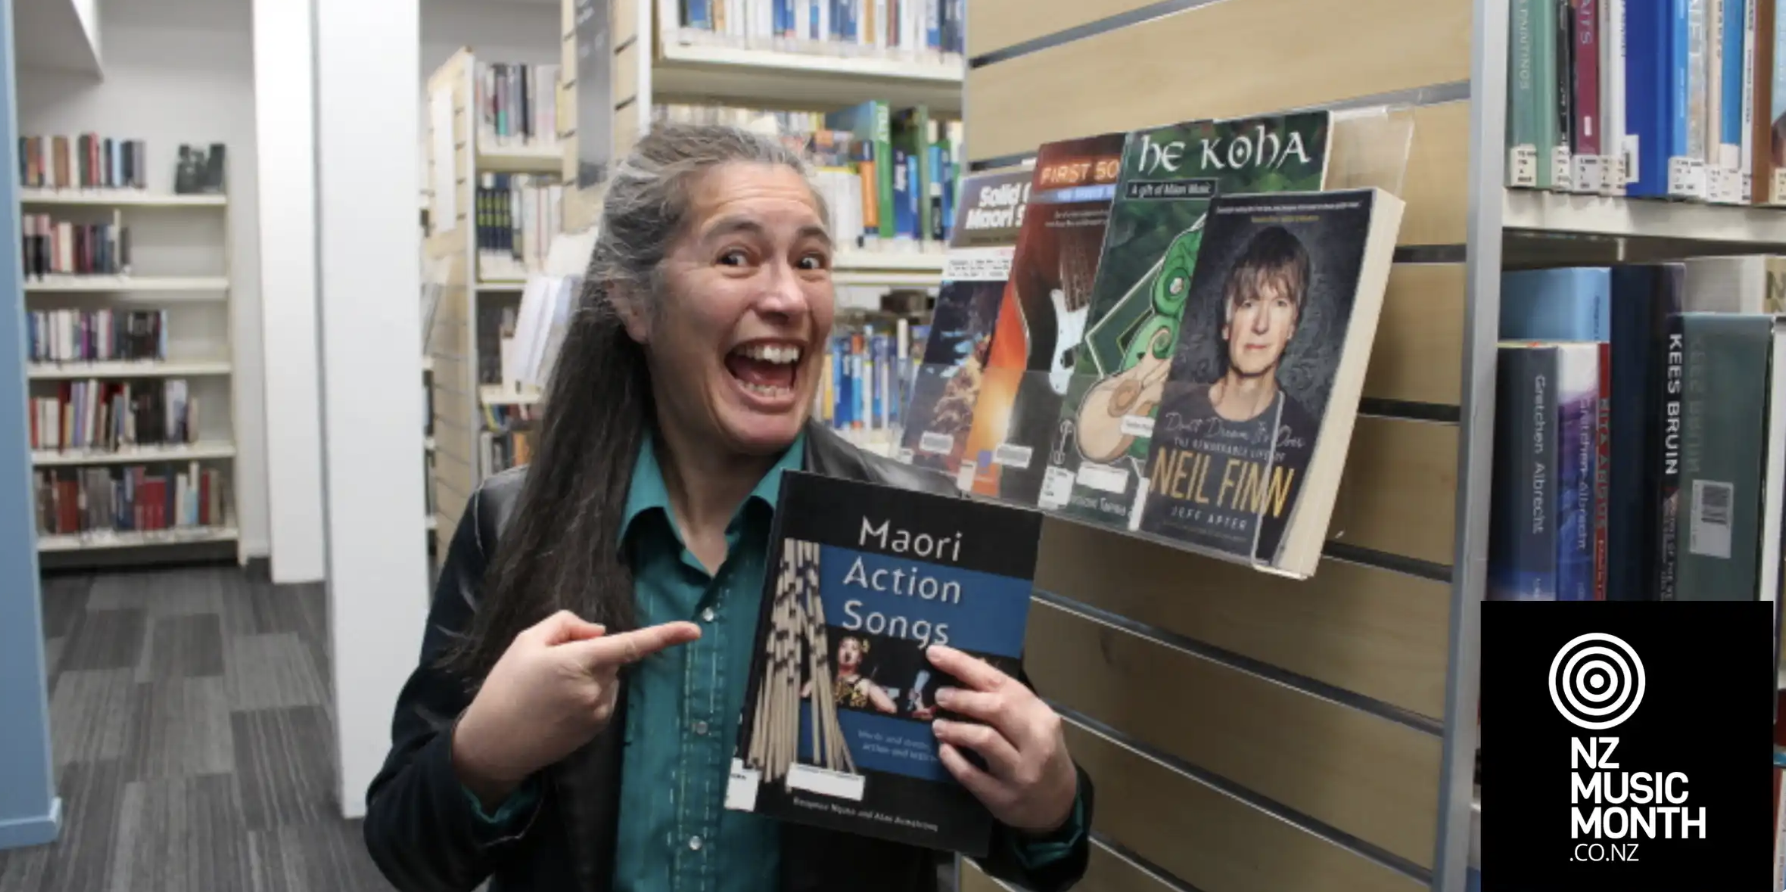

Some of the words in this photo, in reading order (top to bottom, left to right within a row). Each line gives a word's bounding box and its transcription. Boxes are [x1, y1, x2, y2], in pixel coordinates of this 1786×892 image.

[979, 182, 1018, 208] Solid
[1040, 163, 1091, 186] FIRST
[1668, 333, 1683, 394] KEES
[1534, 374, 1546, 454] Gretchen
[1664, 401, 1681, 475] BRUIN
[1149, 446, 1212, 504] NEIL
[1216, 457, 1295, 519] FINN
[1532, 462, 1545, 534] Albrecht
[859, 514, 963, 562] Maori
[1171, 505, 1203, 521] JEFF
[1207, 513, 1248, 531] APTER
[842, 555, 962, 605] Action
[842, 598, 949, 651] Songs
